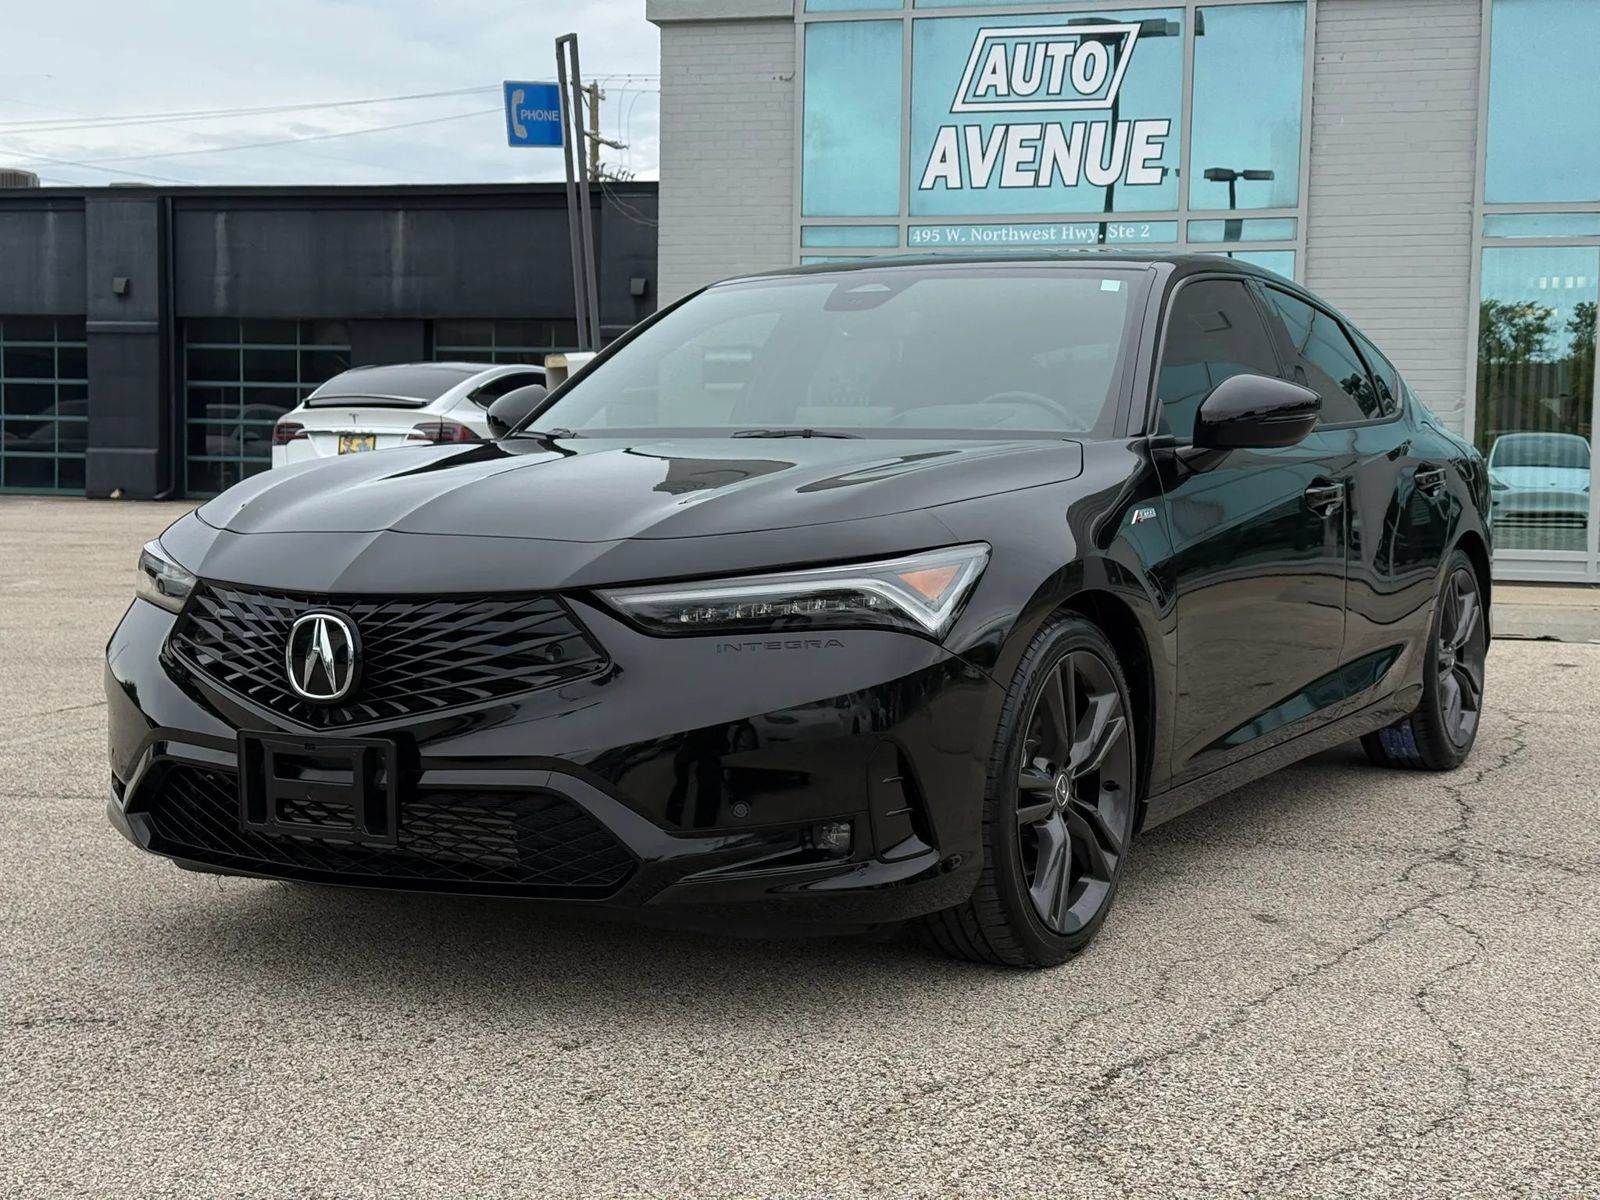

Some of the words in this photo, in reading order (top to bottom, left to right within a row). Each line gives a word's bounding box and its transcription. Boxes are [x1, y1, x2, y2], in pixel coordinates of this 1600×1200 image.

[973, 40, 1108, 97] AUTO
[521, 109, 559, 121] PHONE
[919, 119, 1171, 190] AVENUE
[912, 229, 940, 242] 495
[946, 228, 966, 242] W.
[971, 225, 1057, 241] Northwest
[1062, 225, 1104, 242] Hwy.
[1109, 224, 1135, 238] Ste
[1140, 224, 1150, 238] 2
[717, 639, 845, 653] INTEGRA
